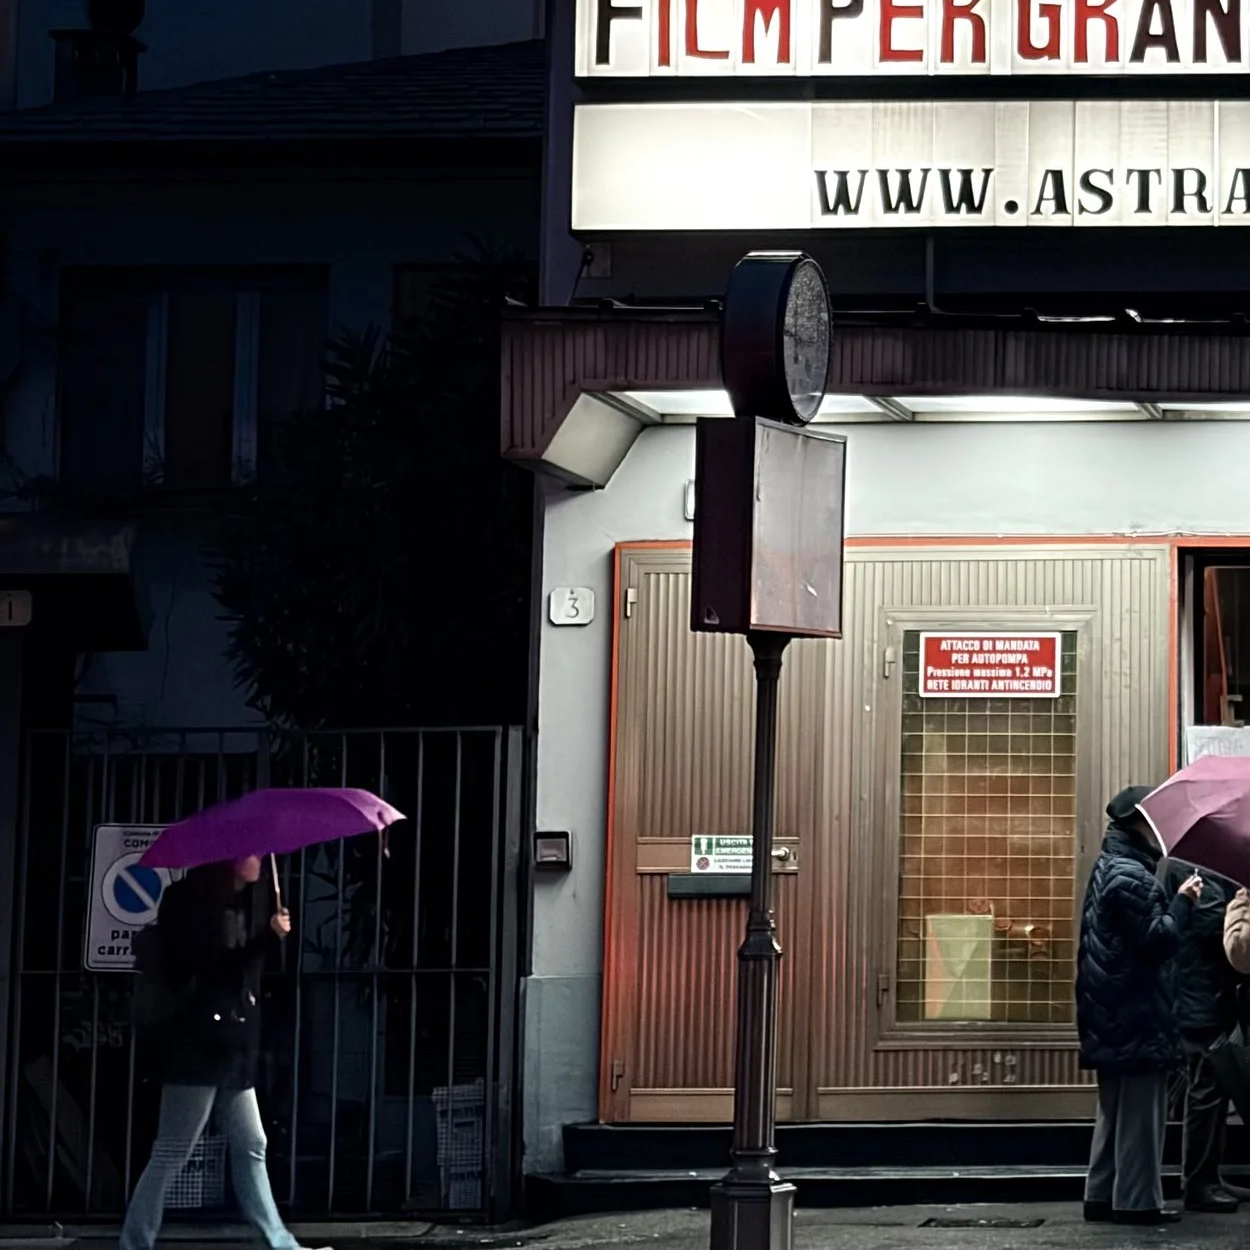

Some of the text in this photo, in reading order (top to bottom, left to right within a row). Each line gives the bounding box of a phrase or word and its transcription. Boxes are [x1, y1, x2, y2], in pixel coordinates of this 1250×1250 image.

[566, 597, 580, 619] 3
[940, 640, 1040, 651] ATTACCO DI MANDATA
[951, 653, 1028, 664] PER AUTOPOMPA
[927, 666, 970, 677] Pressione
[927, 680, 1052, 690] RETE IDRANTI ANTINCENDIO
